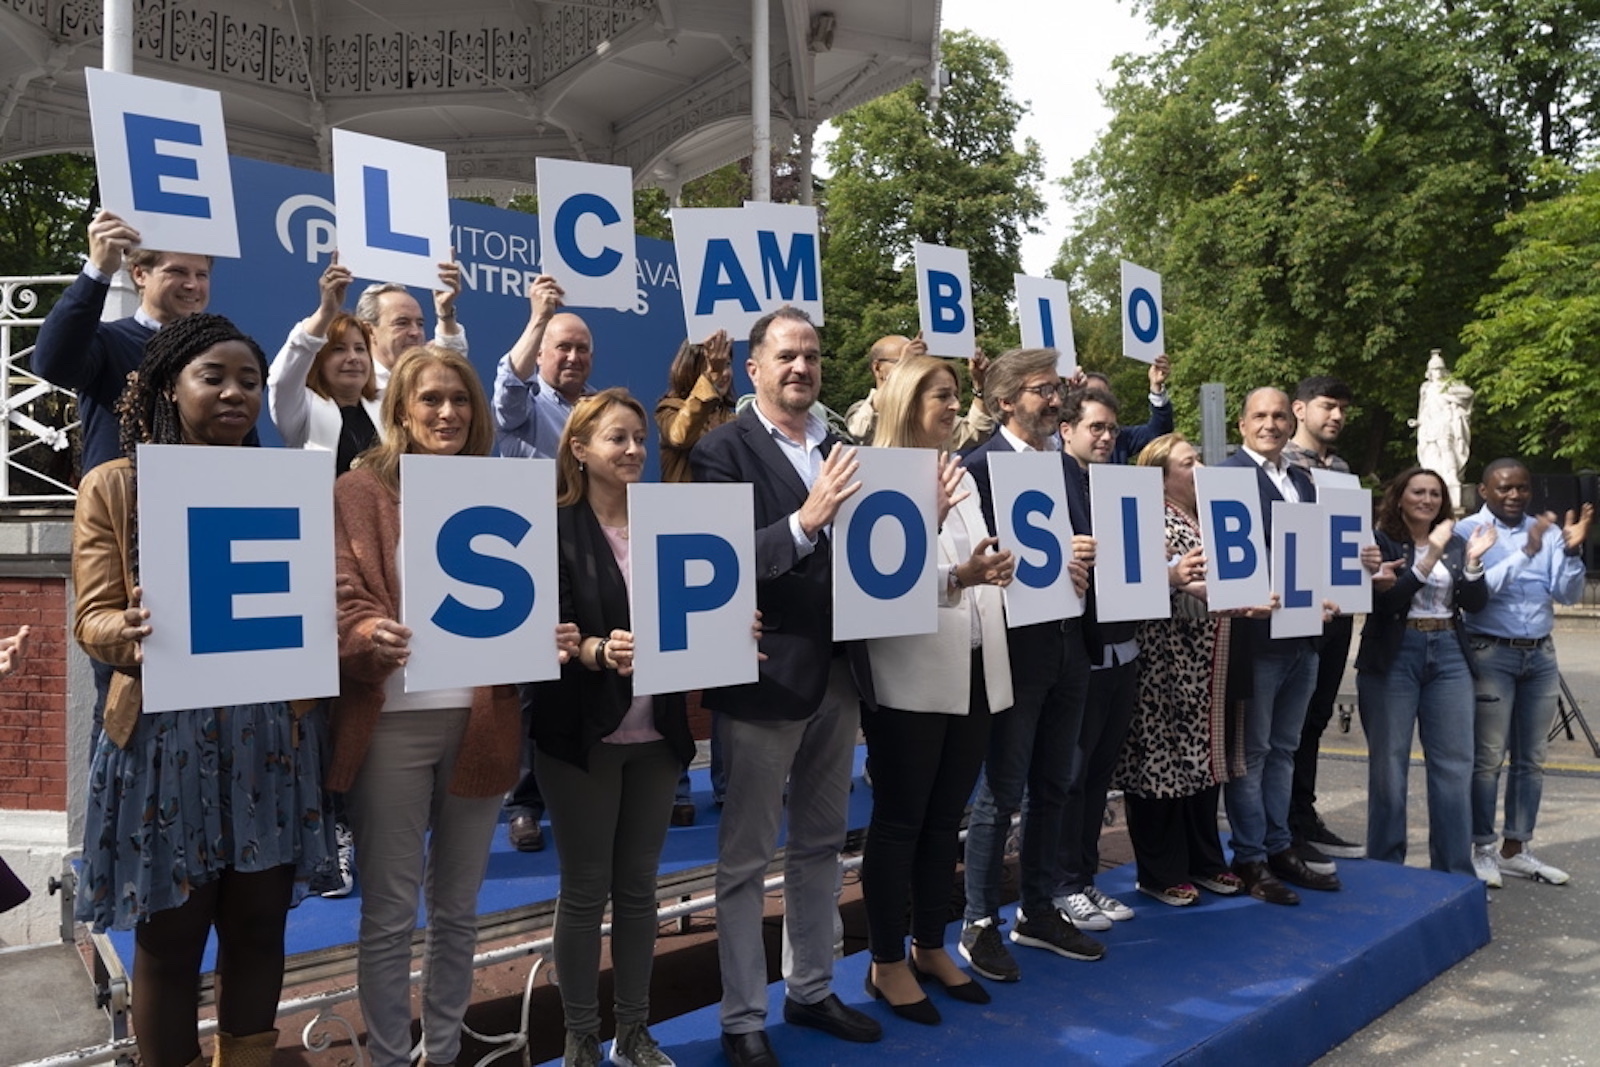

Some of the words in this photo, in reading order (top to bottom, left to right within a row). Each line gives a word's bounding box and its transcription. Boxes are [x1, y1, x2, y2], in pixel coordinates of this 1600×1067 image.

[123, 112, 213, 219] E
[306, 218, 337, 264] p
[362, 166, 432, 257] L
[553, 193, 623, 278] C
[450, 224, 542, 267] ITORI
[636, 257, 680, 290] AVA
[454, 259, 544, 299] NTRE
[695, 238, 763, 316] A
[756, 230, 819, 302] M
[927, 270, 966, 334] B
[1038, 297, 1056, 348] I
[1128, 287, 1159, 343] O
[430, 505, 535, 639] S
[847, 490, 928, 600] O
[1011, 490, 1062, 589] S
[1121, 496, 1143, 584] I
[1210, 500, 1258, 581] B
[1285, 533, 1313, 608] L
[1331, 515, 1362, 587] E
[186, 507, 304, 655] E
[656, 533, 741, 652] P
